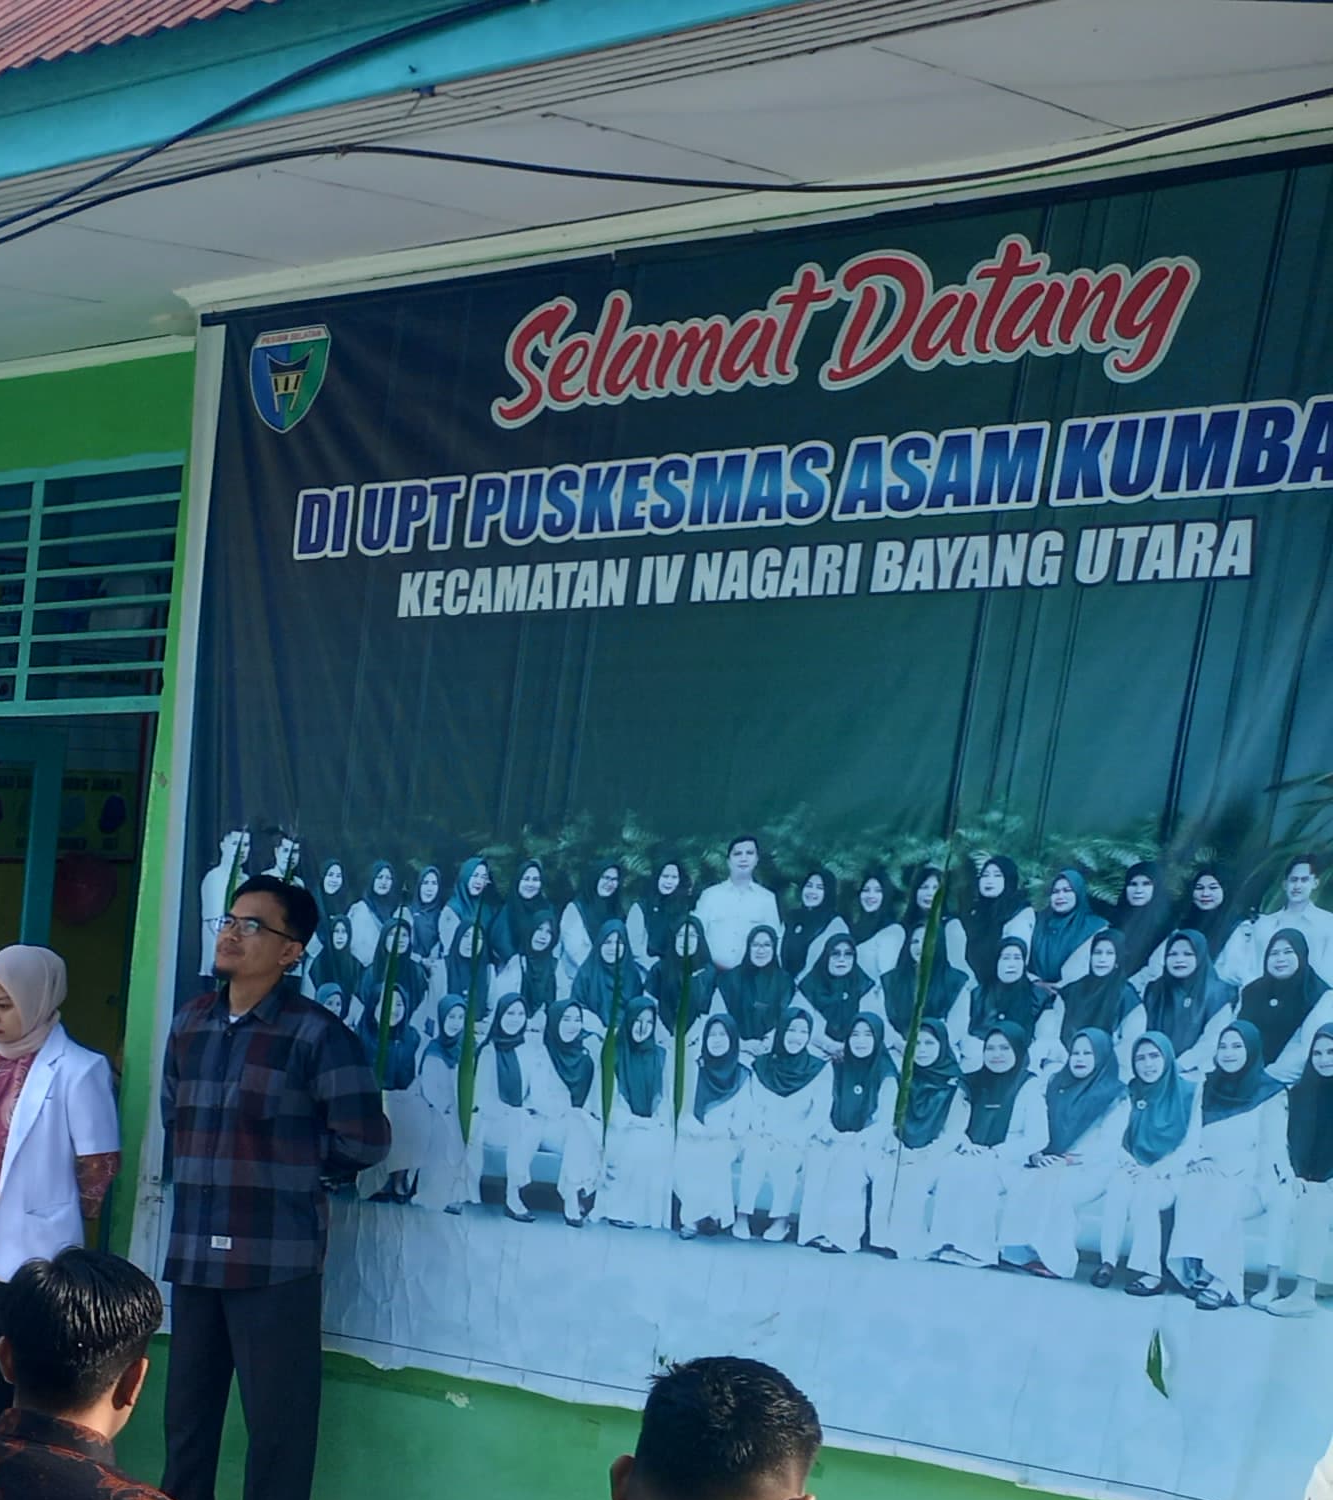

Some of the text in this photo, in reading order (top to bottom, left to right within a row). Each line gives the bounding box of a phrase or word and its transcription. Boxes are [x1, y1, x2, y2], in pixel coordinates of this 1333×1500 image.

[494, 237, 1196, 426] Selamat Datang
[295, 489, 352, 557] DI
[360, 479, 465, 553] UPT
[464, 444, 832, 545] PUSKESMAS
[836, 426, 1046, 518] ASAM
[398, 519, 1253, 617] KECAMATAN IV NAGARI BAYANG UTARA
